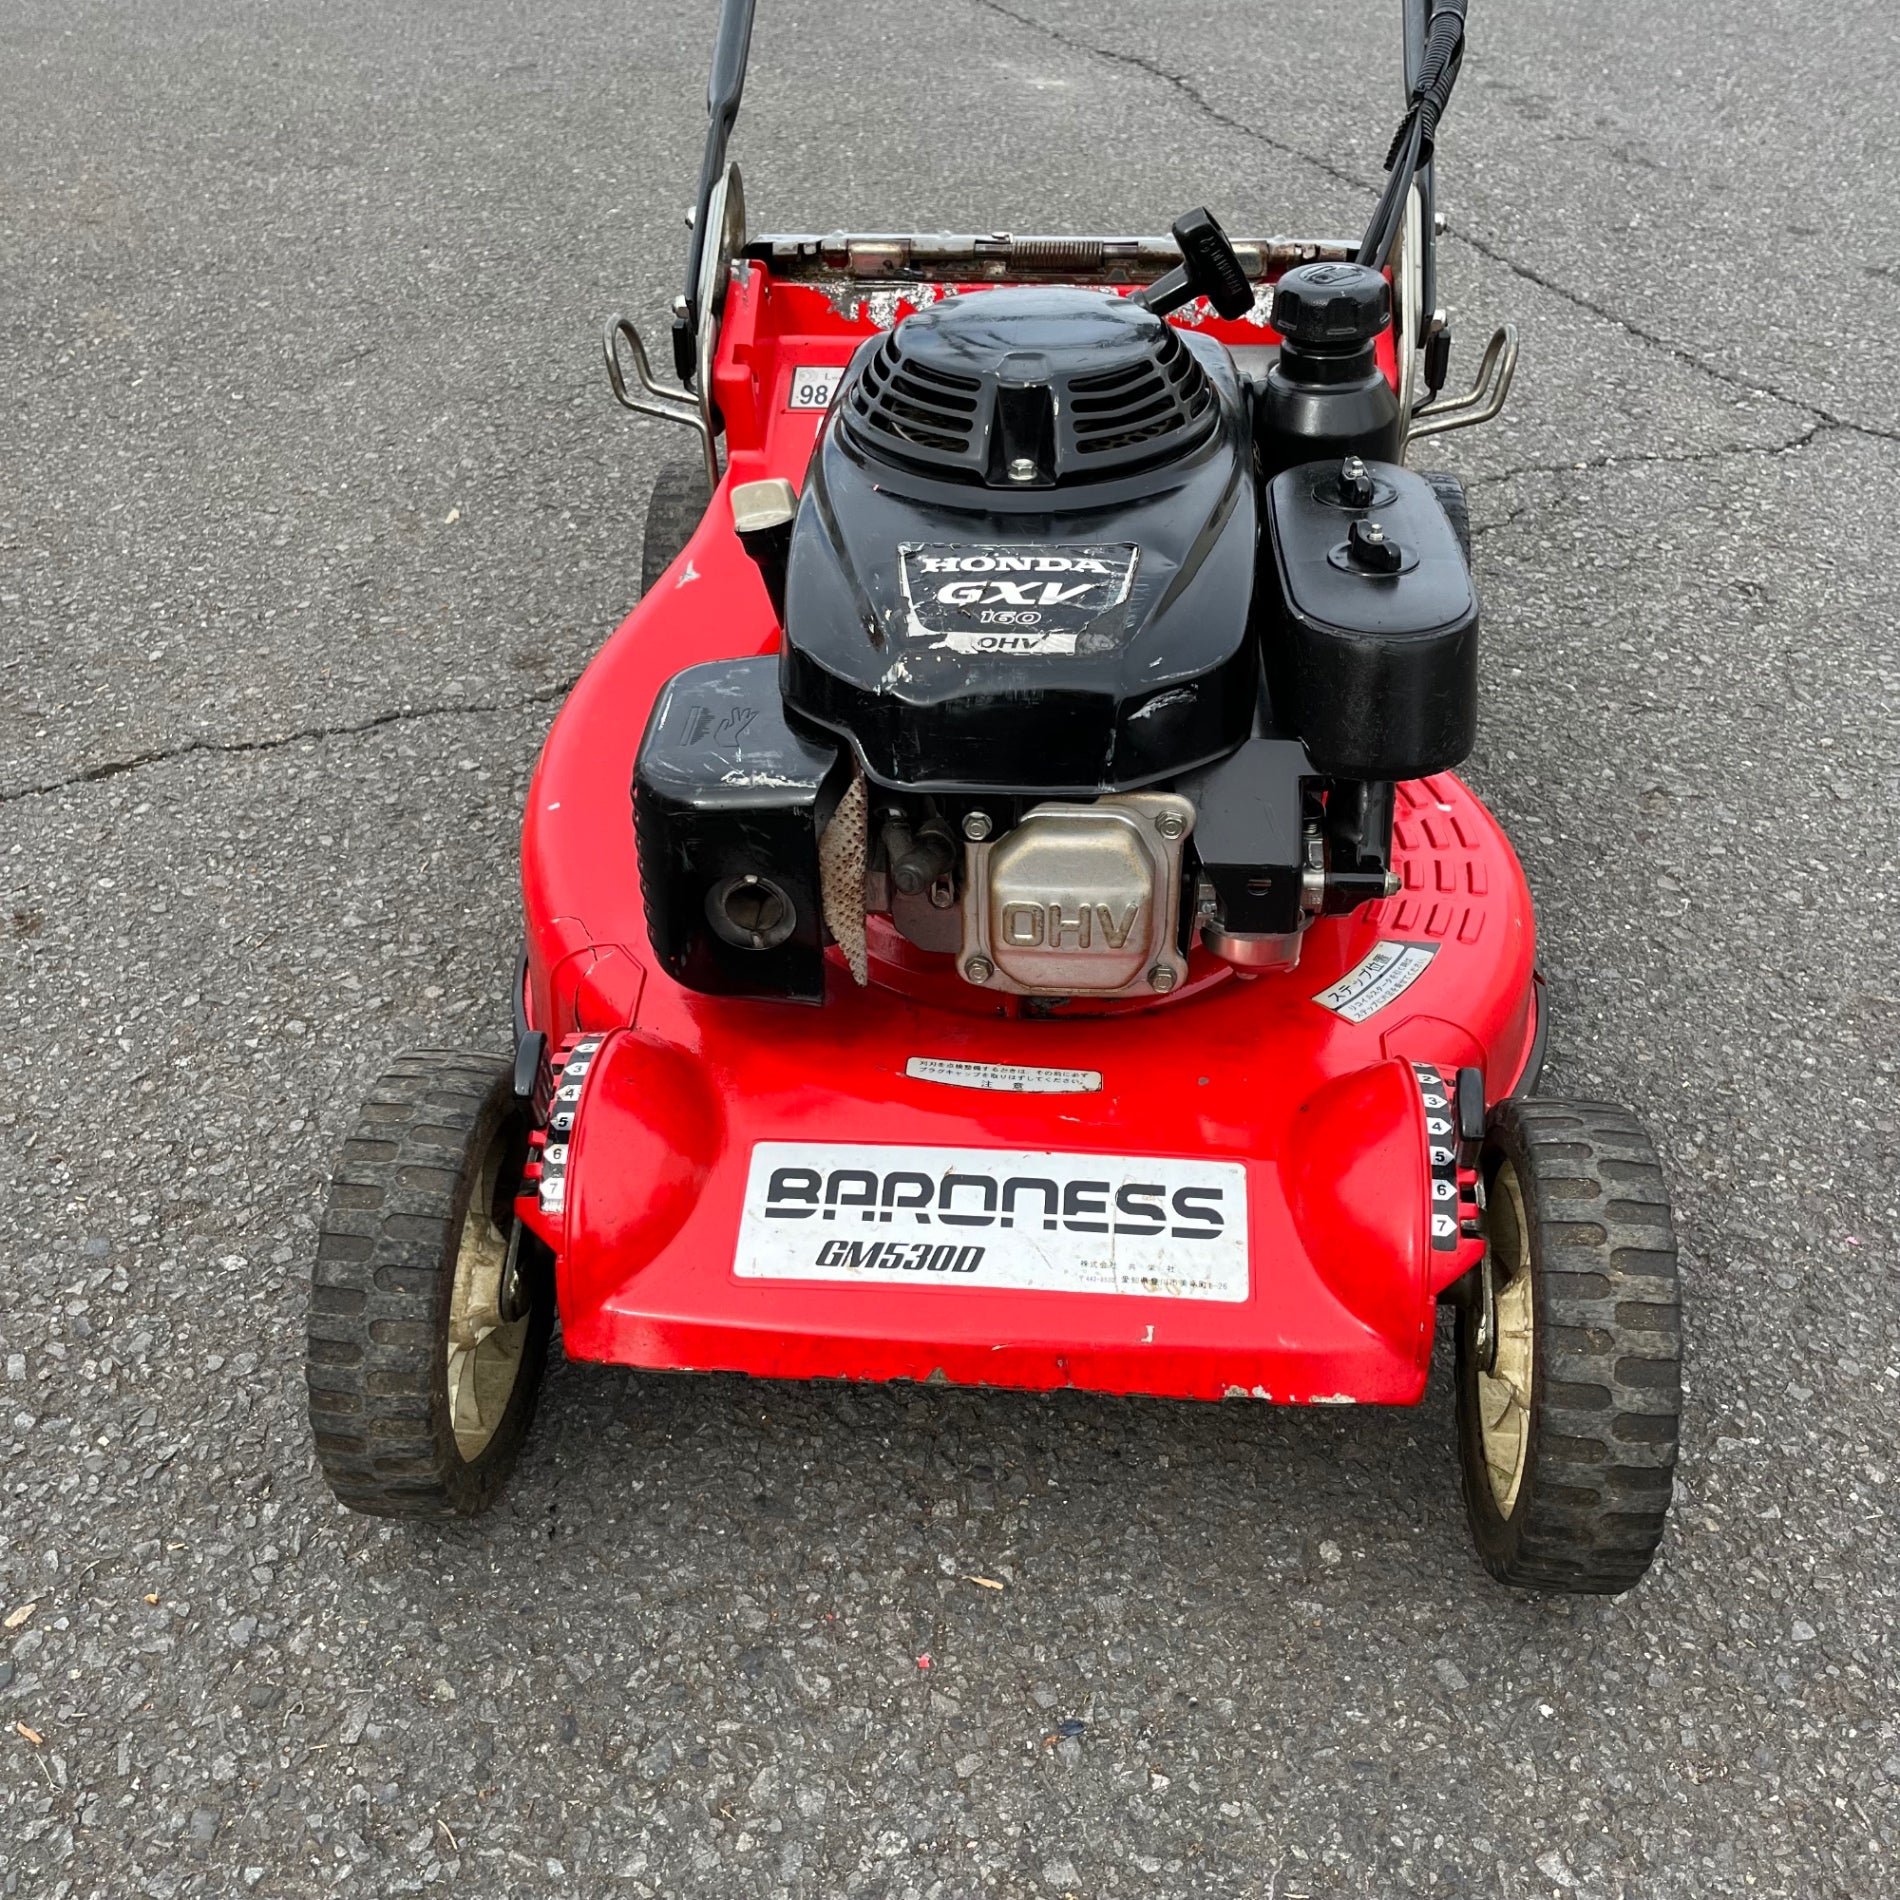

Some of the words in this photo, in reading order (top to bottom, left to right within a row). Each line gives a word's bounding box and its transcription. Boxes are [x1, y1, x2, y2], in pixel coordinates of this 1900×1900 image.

[799, 384, 829, 405] 98
[920, 556, 1111, 573] HONDA
[937, 581, 1094, 605] GXV
[980, 610, 1042, 625] 160
[978, 636, 1042, 649] OHV
[1002, 900, 1140, 949] OHV
[1327, 953, 1393, 1002] ステップ位置
[572, 1064, 582, 1073] 3
[565, 1088, 575, 1099] 4
[1428, 1097, 1438, 1106] 3
[558, 1116, 568, 1128] 5
[1431, 1122, 1442, 1132] 4
[553, 1148, 562, 1159] 6
[1435, 1151, 1445, 1163] 5
[549, 1183, 558, 1194] 7
[1437, 1184, 1447, 1196] 6
[765, 1167, 1225, 1240] BARONESS
[1437, 1220, 1447, 1232] 7
[815, 1239, 986, 1274] GM530D
